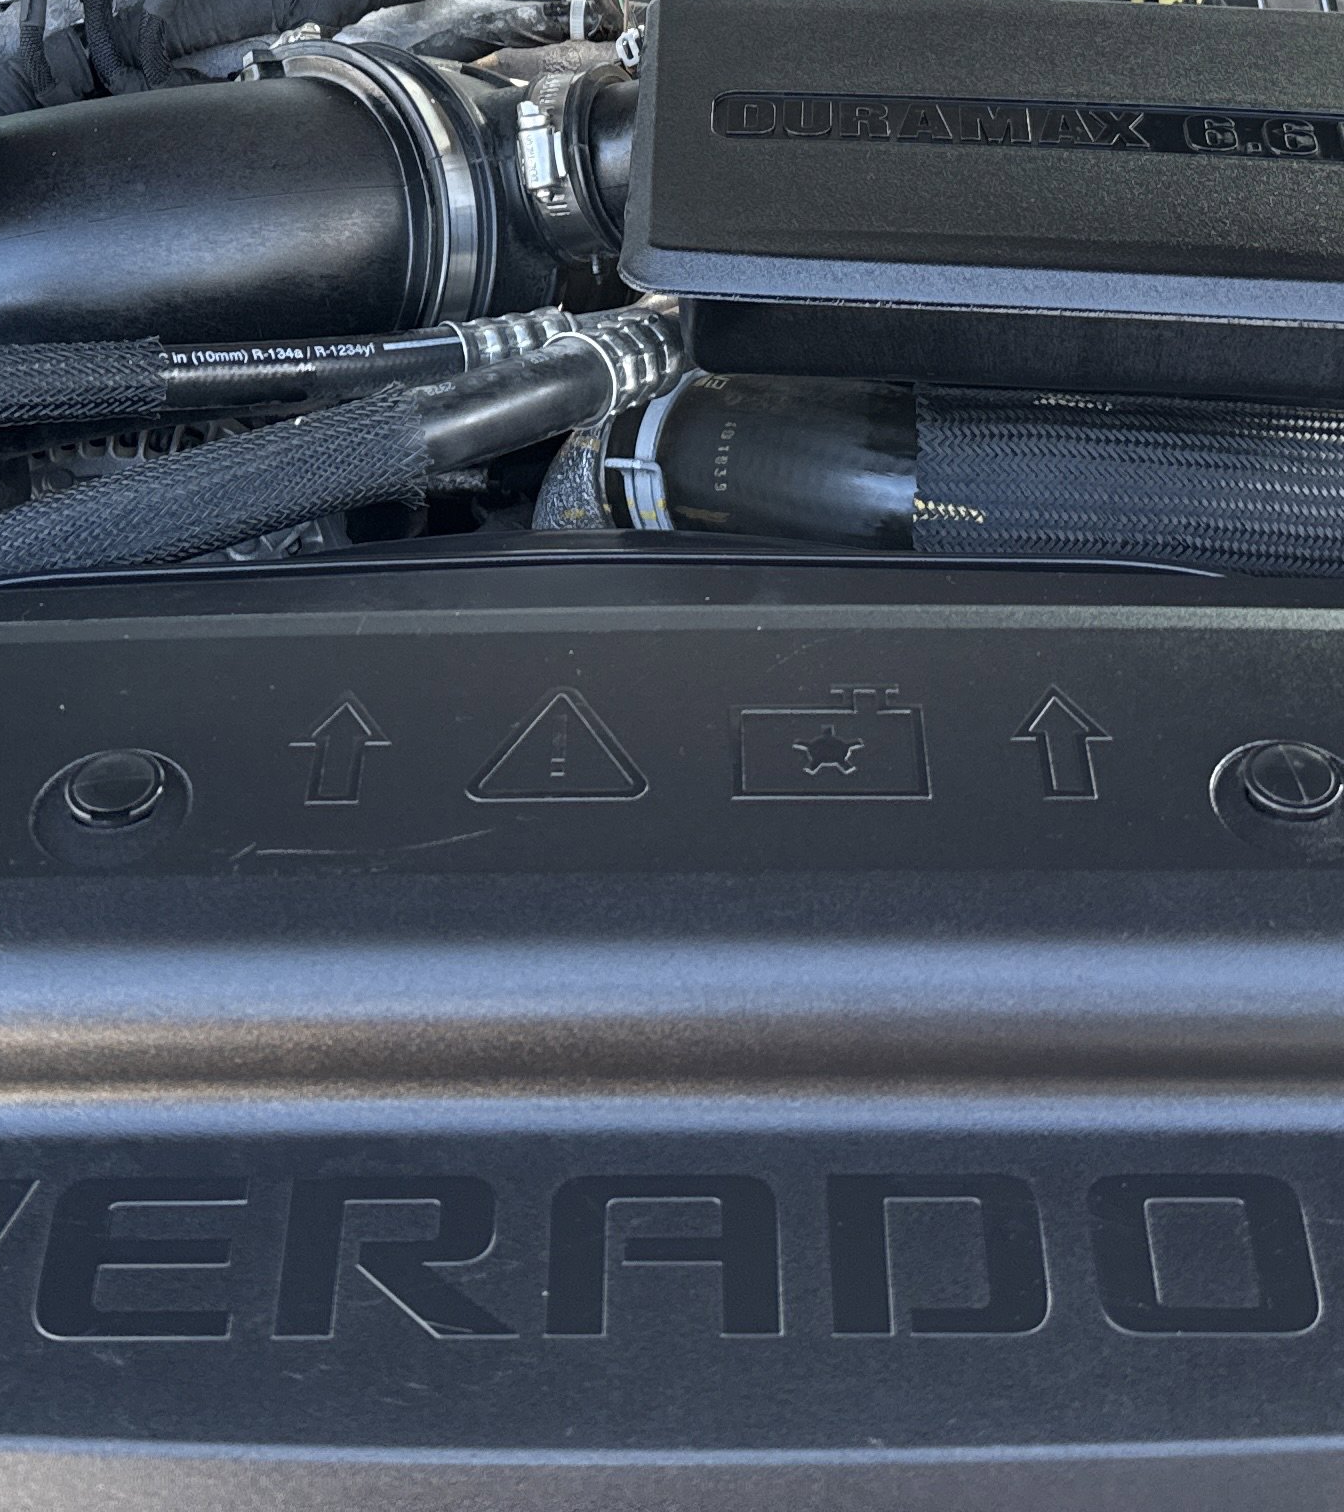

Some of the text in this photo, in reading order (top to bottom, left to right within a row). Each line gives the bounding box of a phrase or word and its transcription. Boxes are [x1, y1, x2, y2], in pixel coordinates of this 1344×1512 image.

[726, 99, 1151, 148] DURAMAX
[1184, 113, 1319, 156] 6.6
[192, 348, 248, 365] (10mm)
[252, 346, 304, 361] R-134a
[314, 341, 376, 358] R-1234yf
